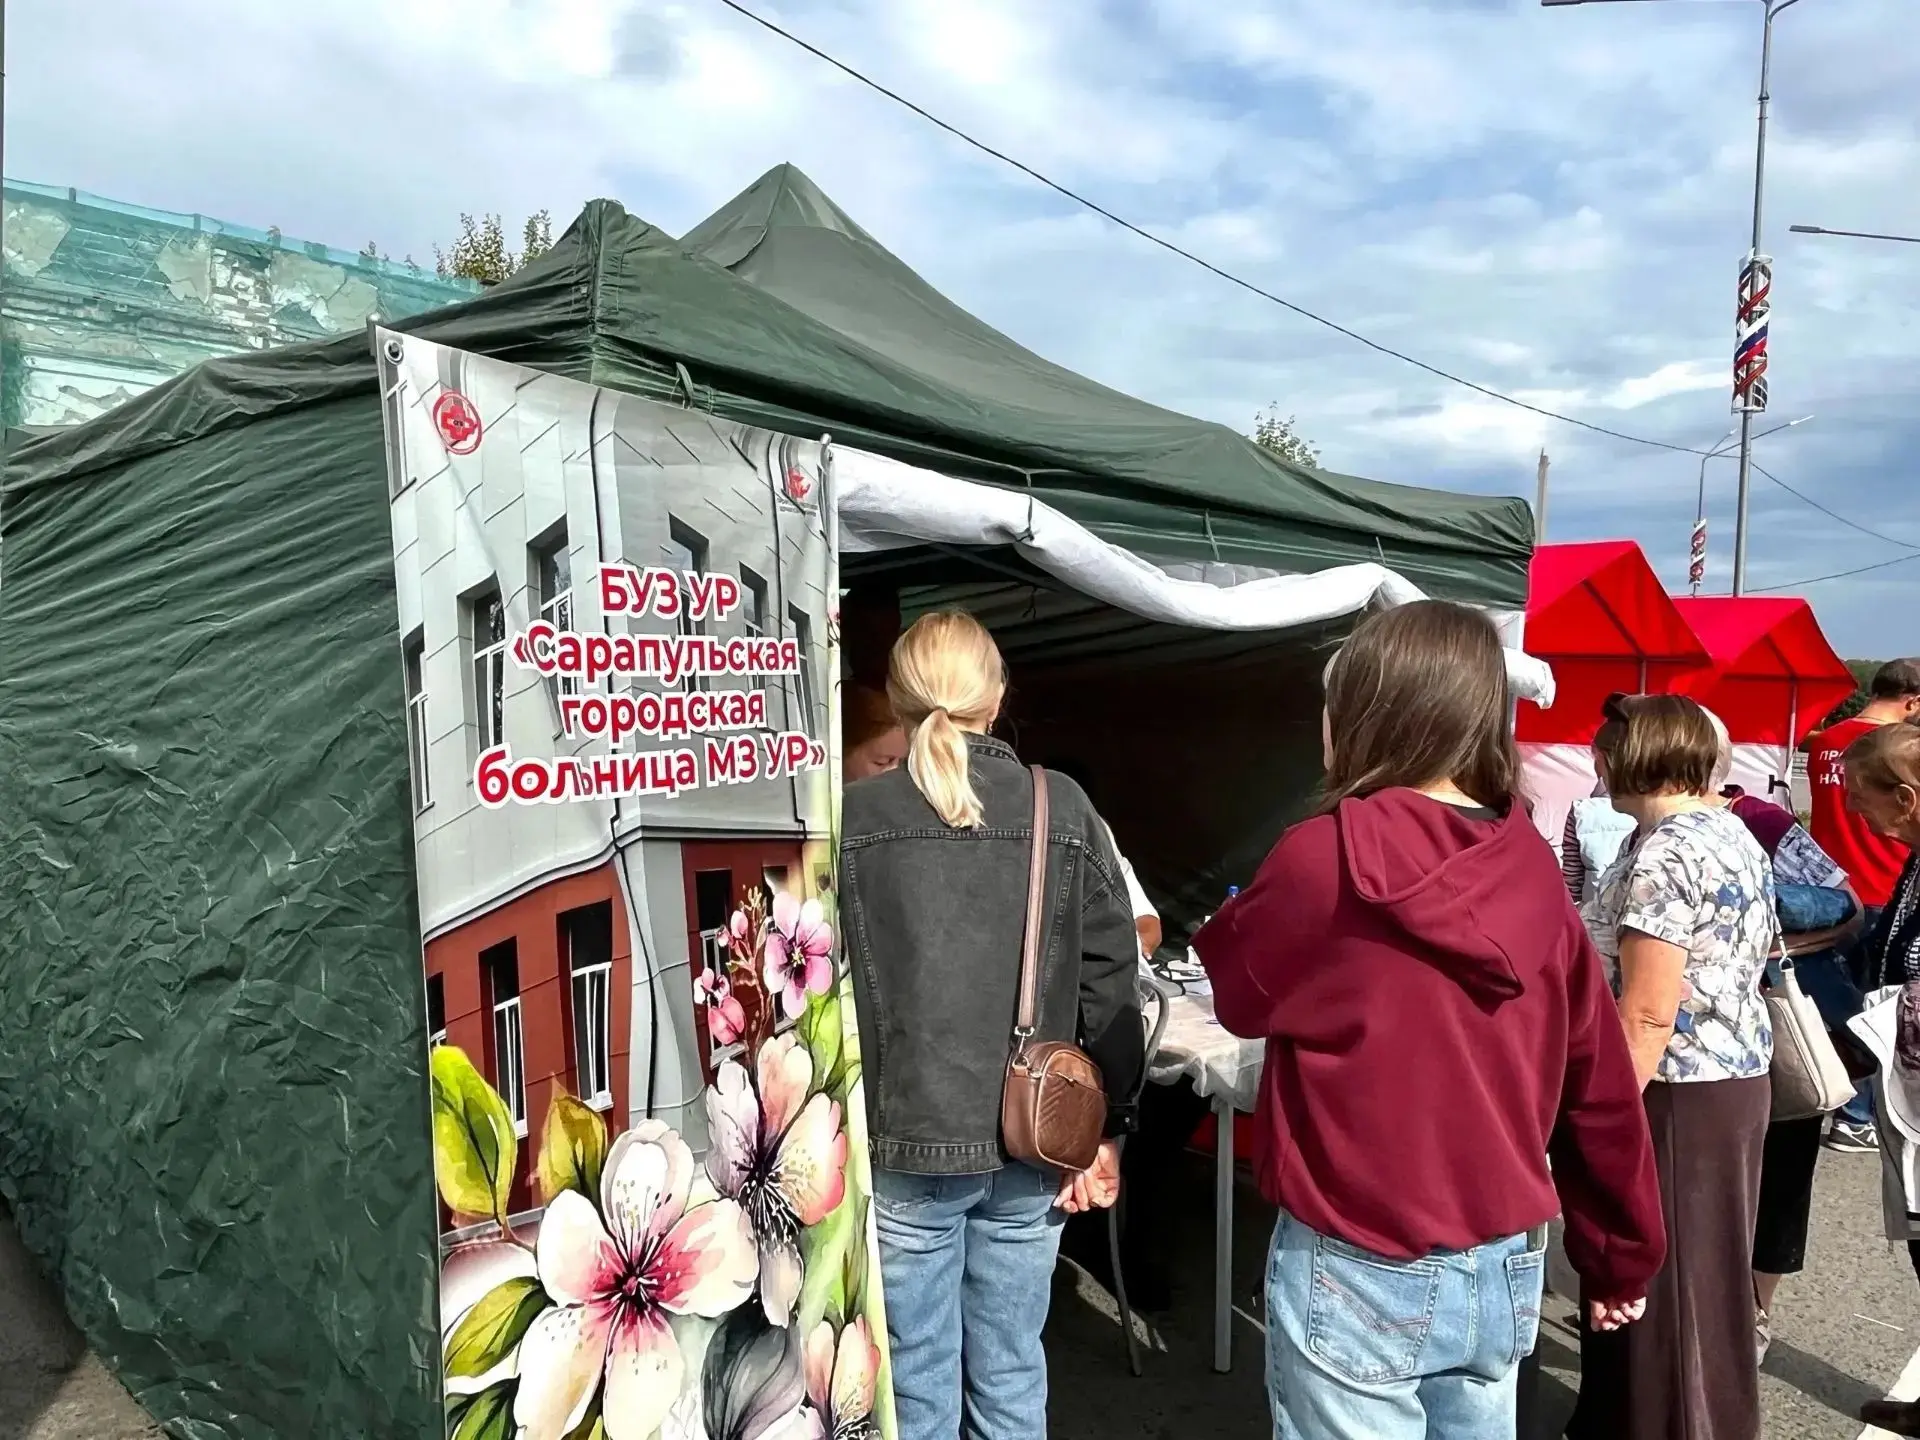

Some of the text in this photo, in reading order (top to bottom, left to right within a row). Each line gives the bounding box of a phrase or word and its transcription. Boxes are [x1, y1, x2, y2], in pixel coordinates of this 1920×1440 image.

[600, 567, 740, 616] БУЗ УР
[513, 624, 798, 683] «Сарапульская
[562, 693, 766, 743] городская
[478, 734, 826, 804] больница МЗ УР»
[1820, 750, 1844, 761] ПР
